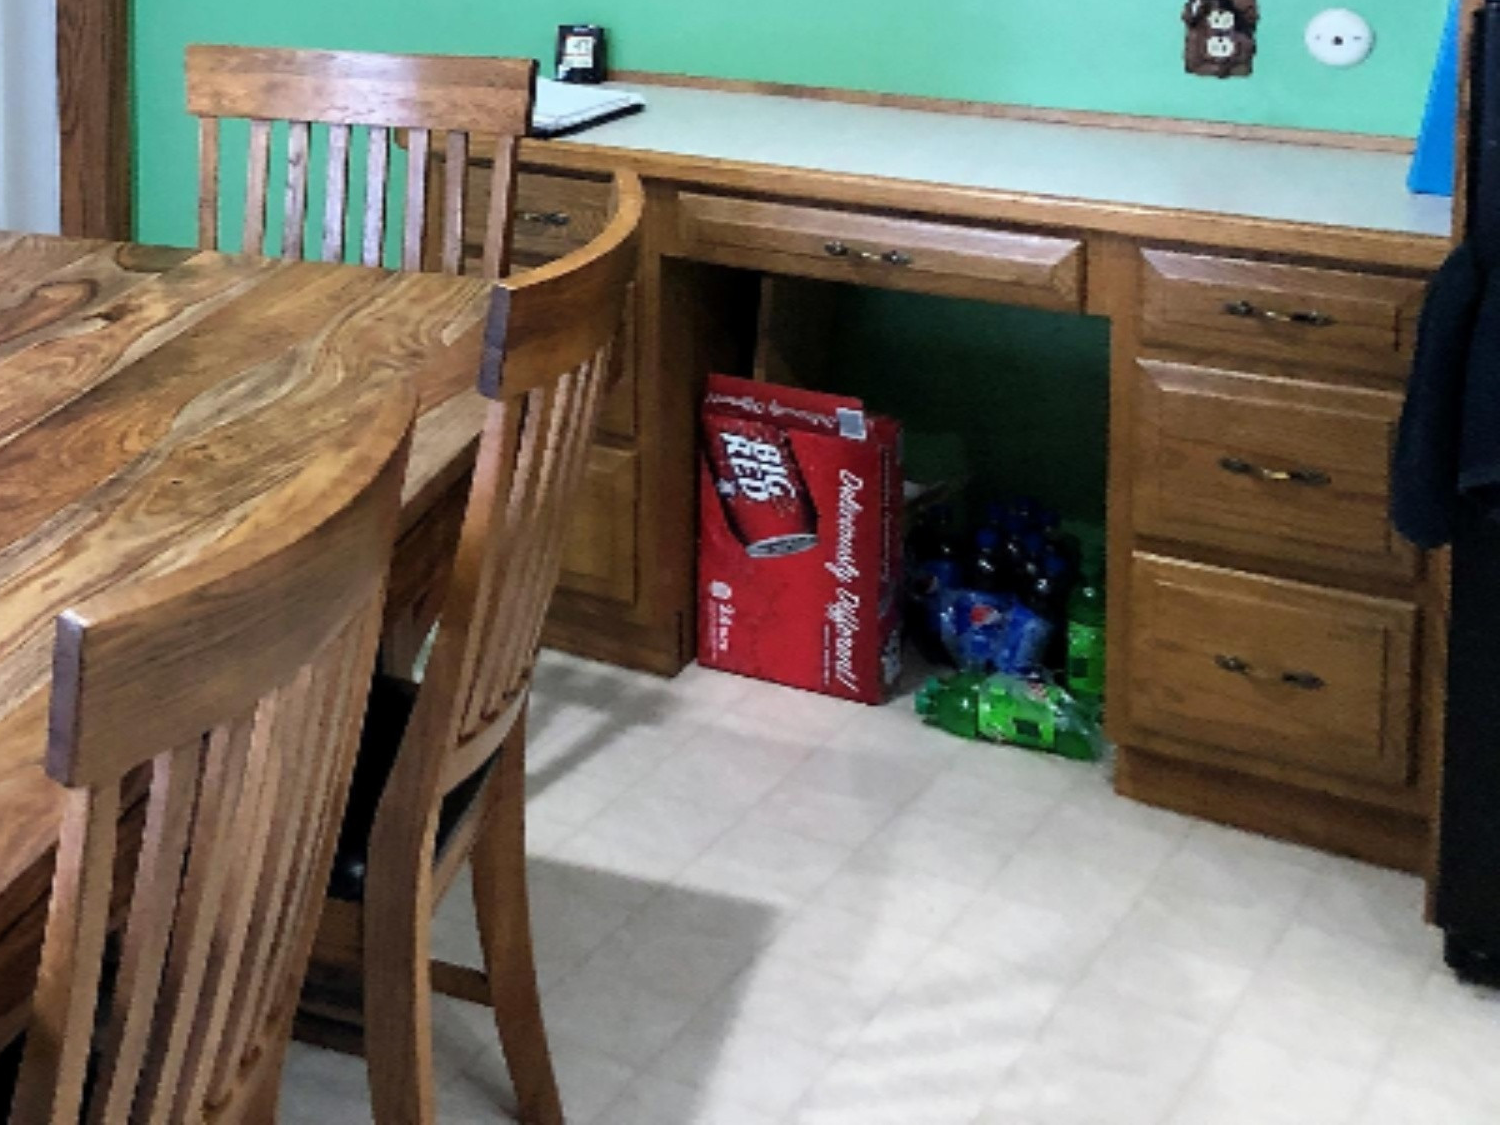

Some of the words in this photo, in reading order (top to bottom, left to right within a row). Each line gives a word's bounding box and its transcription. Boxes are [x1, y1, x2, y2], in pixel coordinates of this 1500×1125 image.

[720, 431, 772, 502] RED
[752, 434, 797, 500] BIG
[824, 469, 863, 582] Deliciously
[825, 587, 861, 693] Different!
